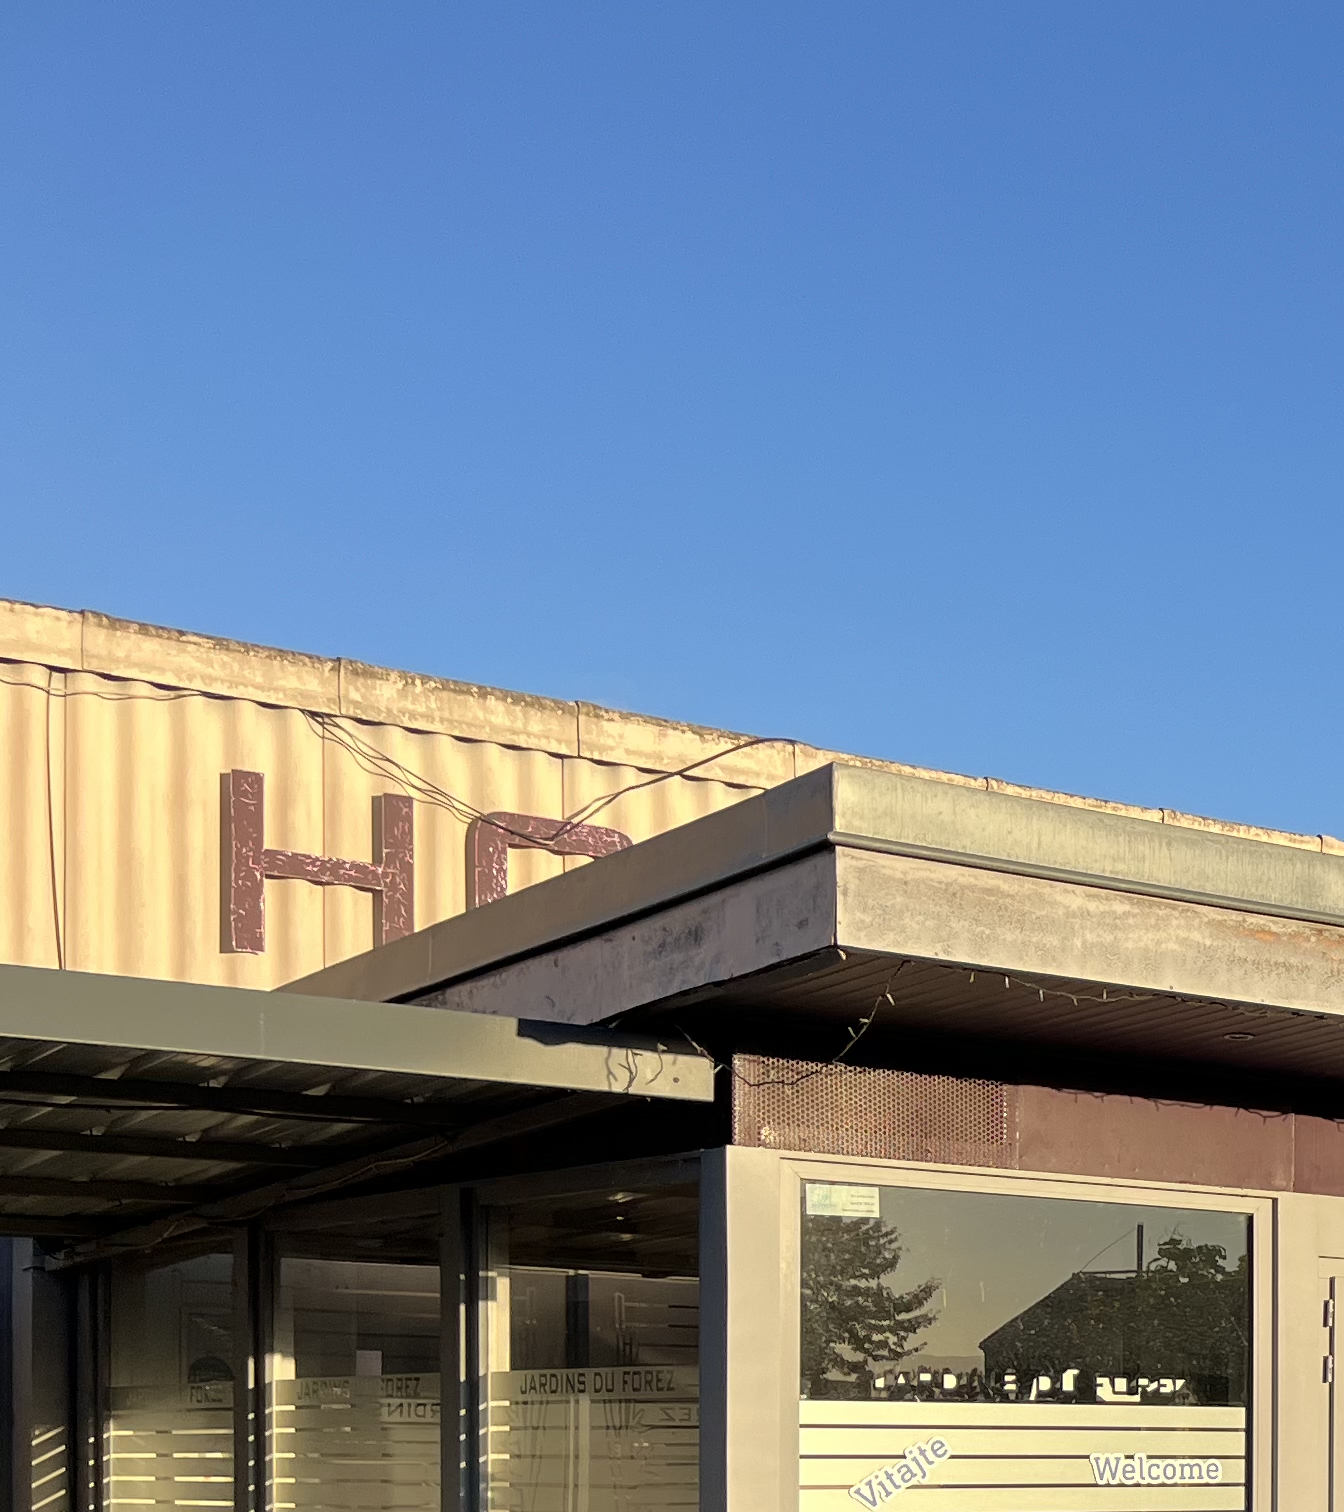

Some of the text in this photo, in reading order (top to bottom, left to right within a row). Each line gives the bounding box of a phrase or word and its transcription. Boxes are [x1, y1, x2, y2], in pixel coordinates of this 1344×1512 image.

[381, 1376, 421, 1398] OREZ
[520, 1369, 675, 1395] JARDINS DU FOREZ
[854, 1440, 948, 1507] Vitajte
[1094, 1457, 1219, 1480] Welcome
